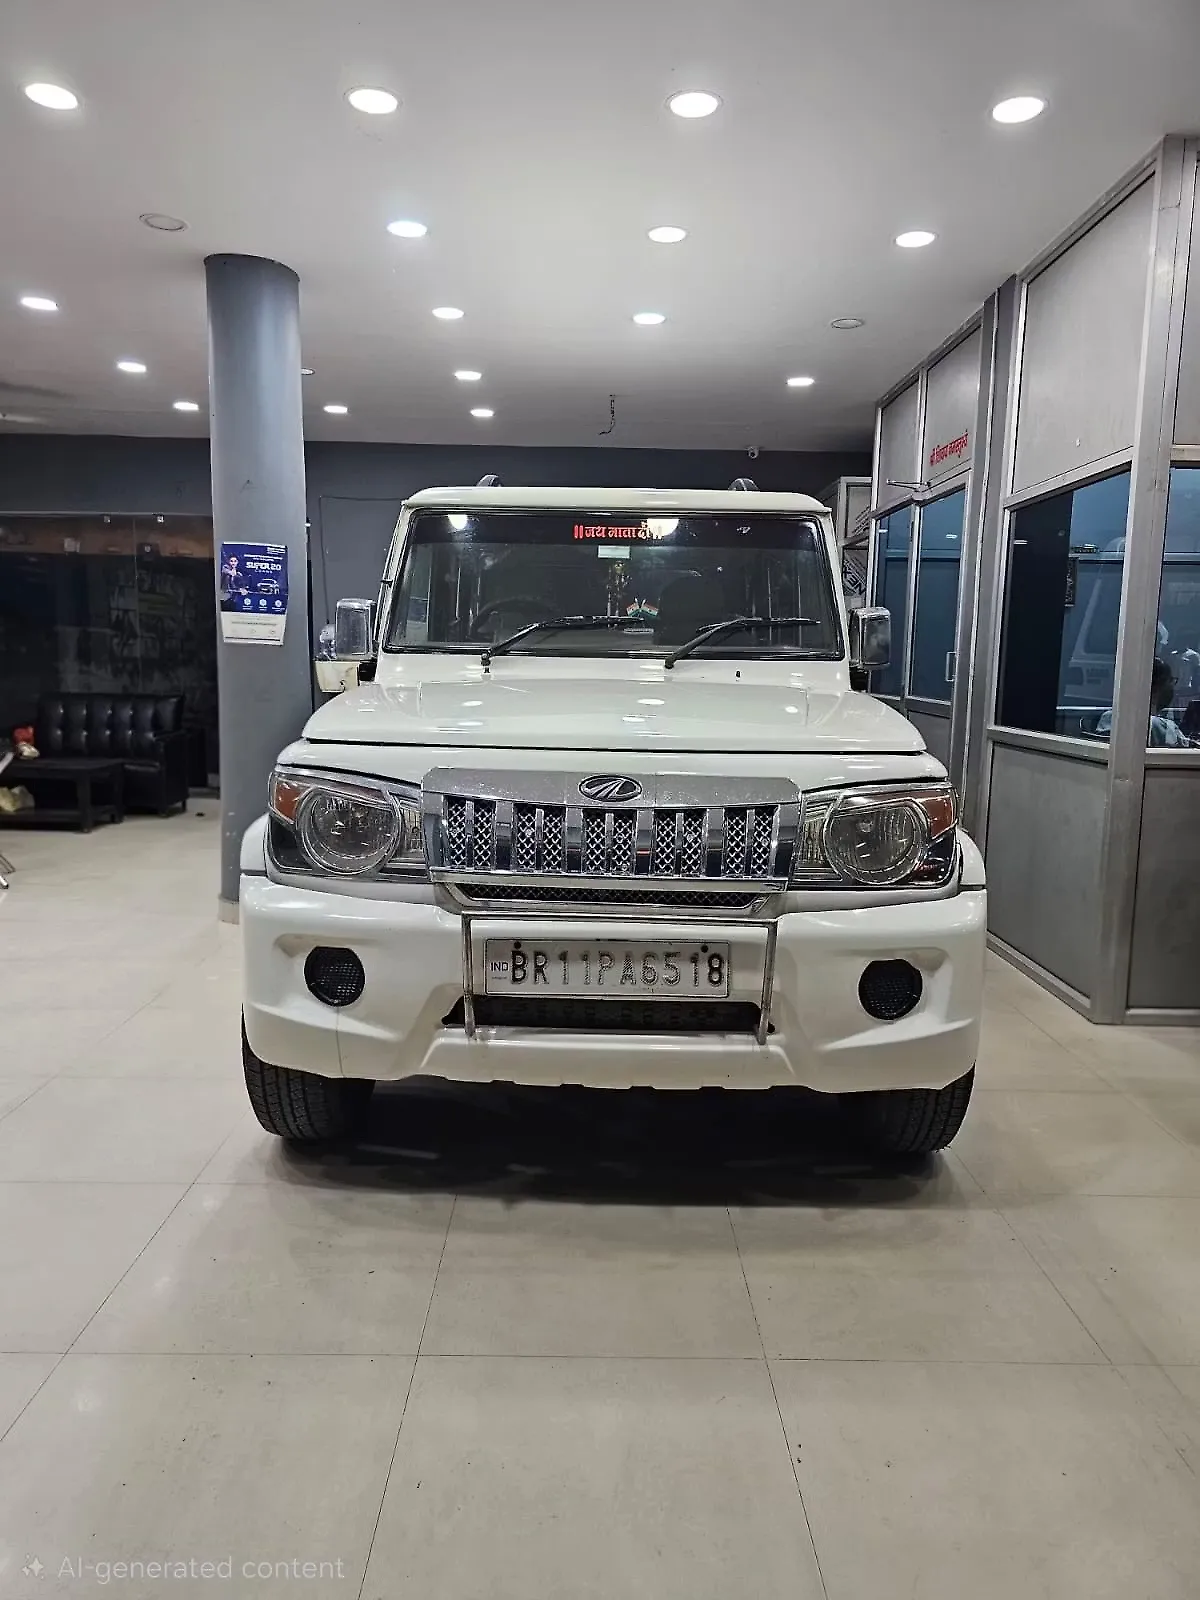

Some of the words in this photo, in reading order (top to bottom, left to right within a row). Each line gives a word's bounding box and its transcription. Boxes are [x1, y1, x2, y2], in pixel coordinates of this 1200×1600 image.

[585, 525, 606, 538] जय
[246, 561, 270, 571] SUPER
[490, 962, 509, 972] IND
[511, 950, 725, 987] BR11PA6518
